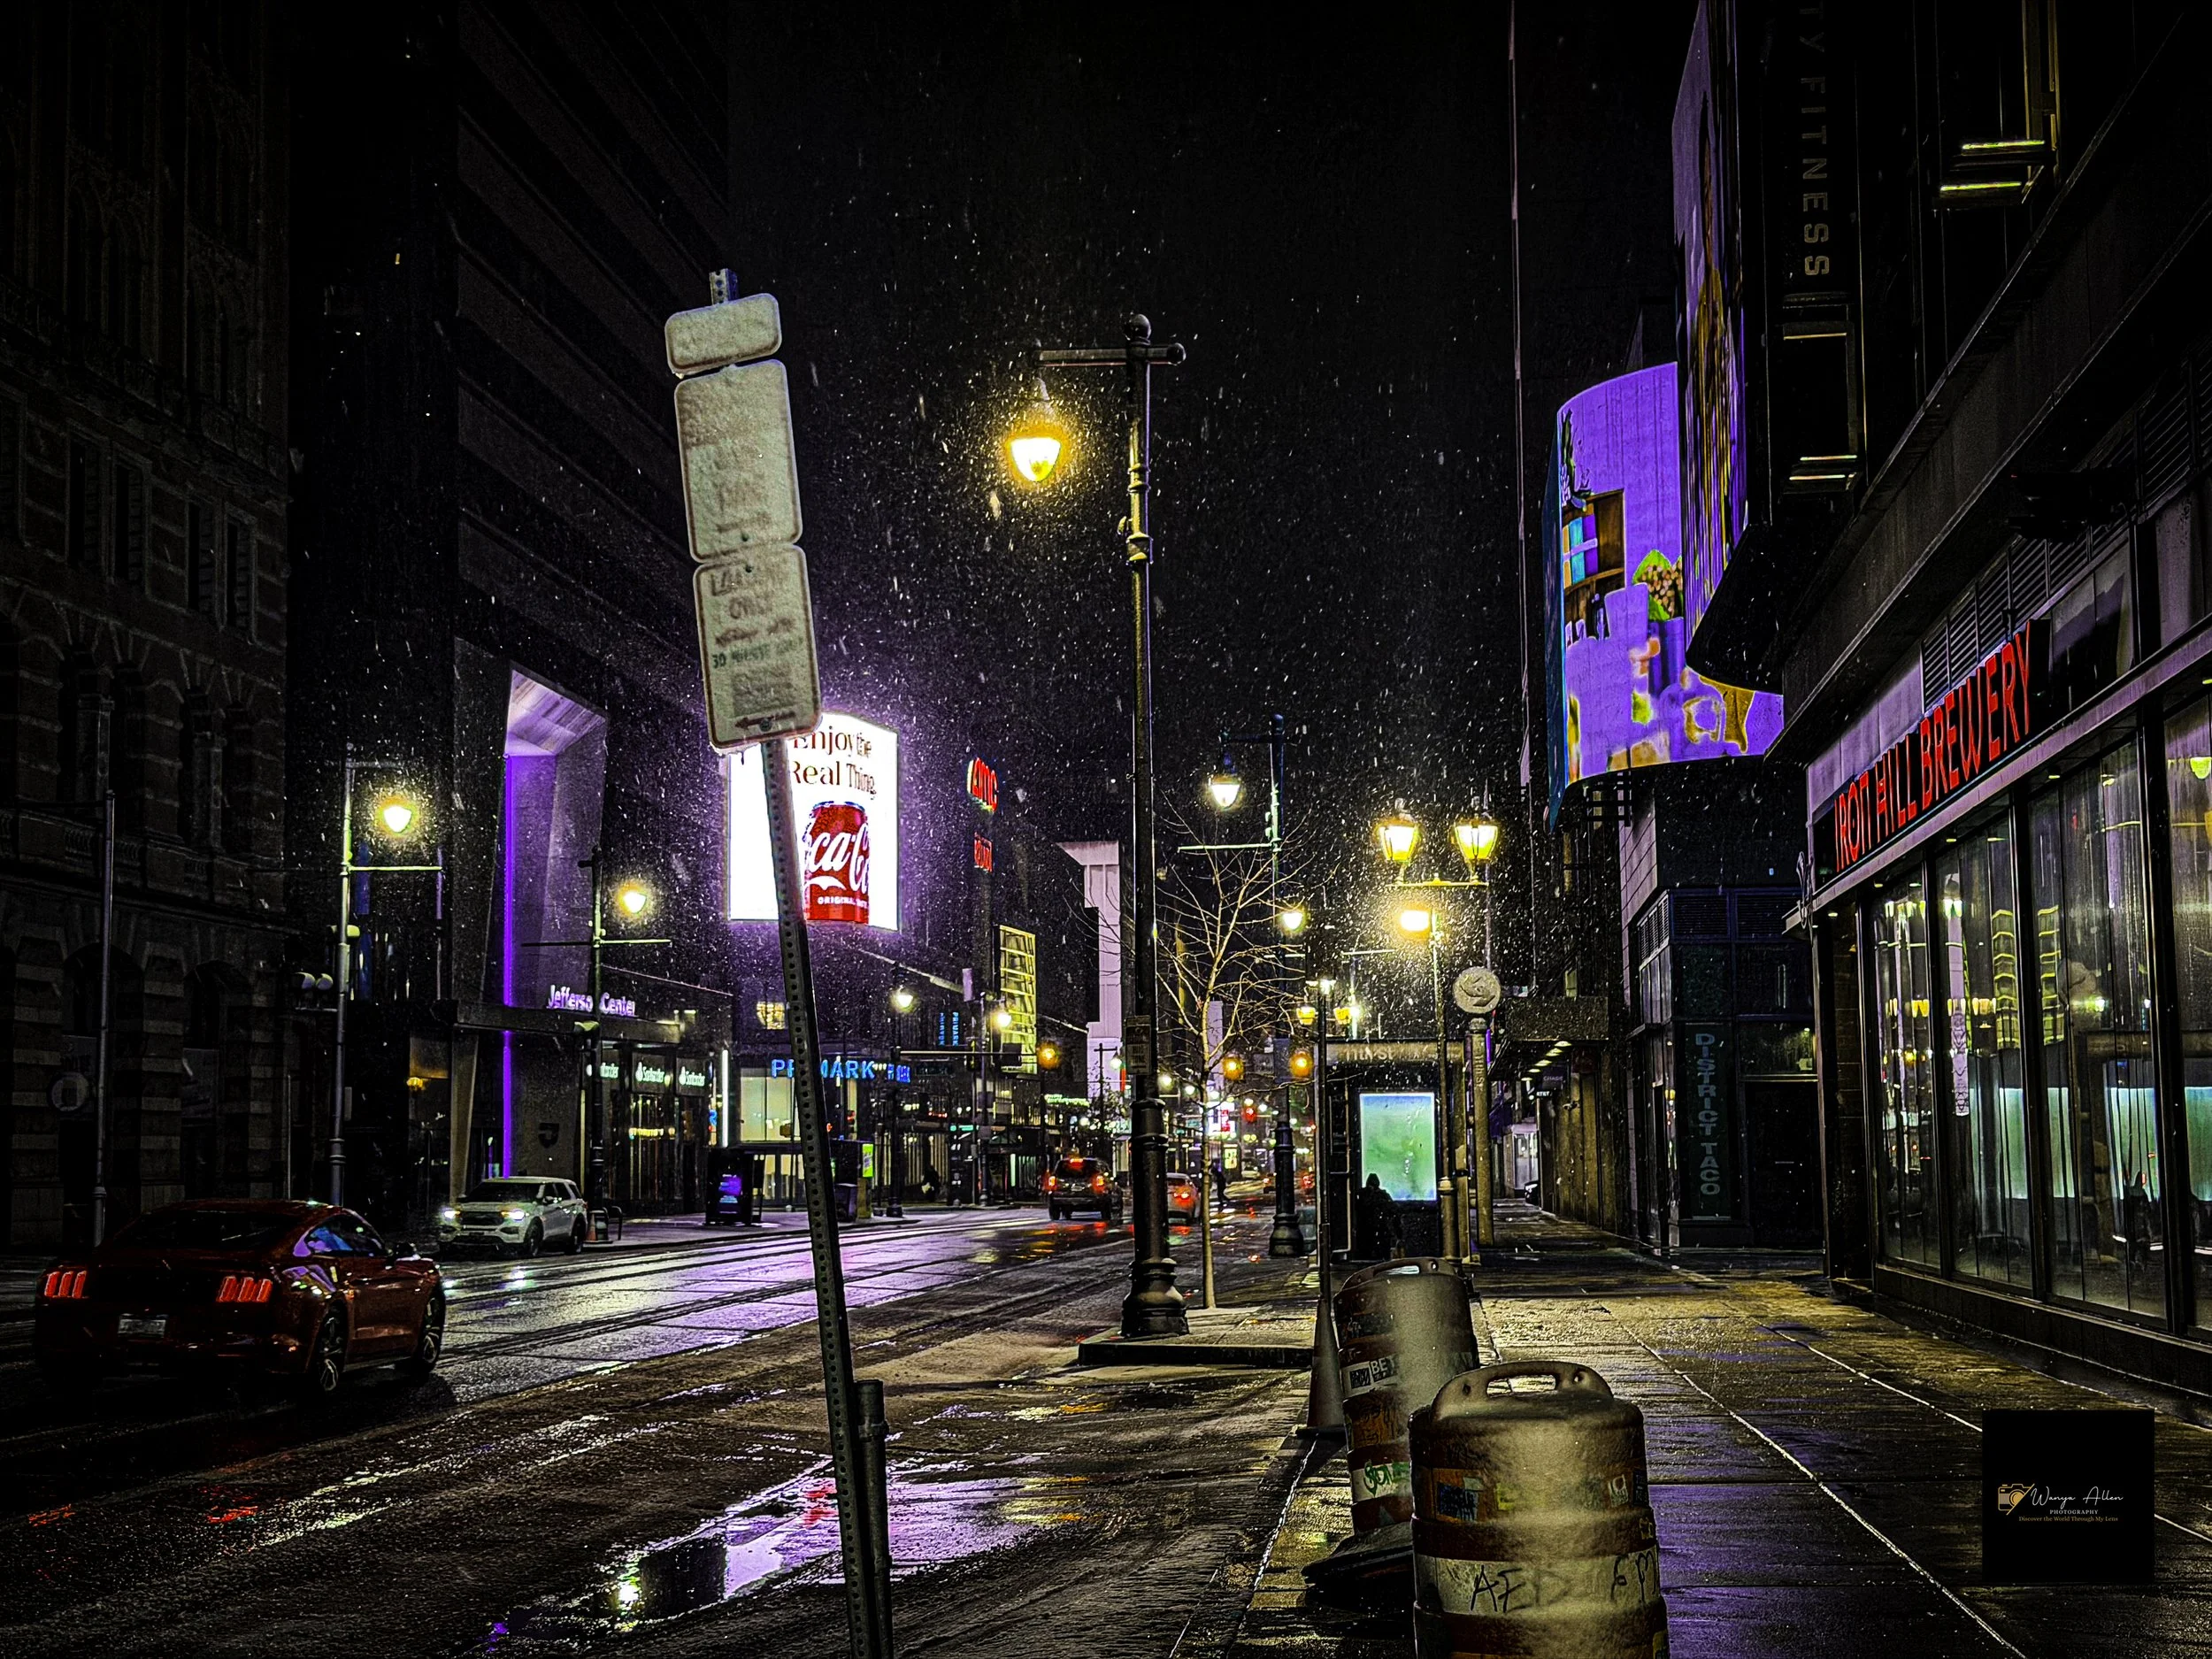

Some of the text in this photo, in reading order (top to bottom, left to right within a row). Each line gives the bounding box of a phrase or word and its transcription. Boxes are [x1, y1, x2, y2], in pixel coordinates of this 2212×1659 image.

[1800, 76, 1830, 276] FITNESS
[793, 725, 853, 757] Enjoy
[1875, 734, 1917, 843] HILL
[1920, 620, 2031, 811] BREWERY
[792, 760, 841, 786] Real
[548, 984, 636, 1017] Jefferso Center
[771, 1058, 876, 1080] PRARK
[1695, 1033, 1721, 1195] DISTRICT TACO
